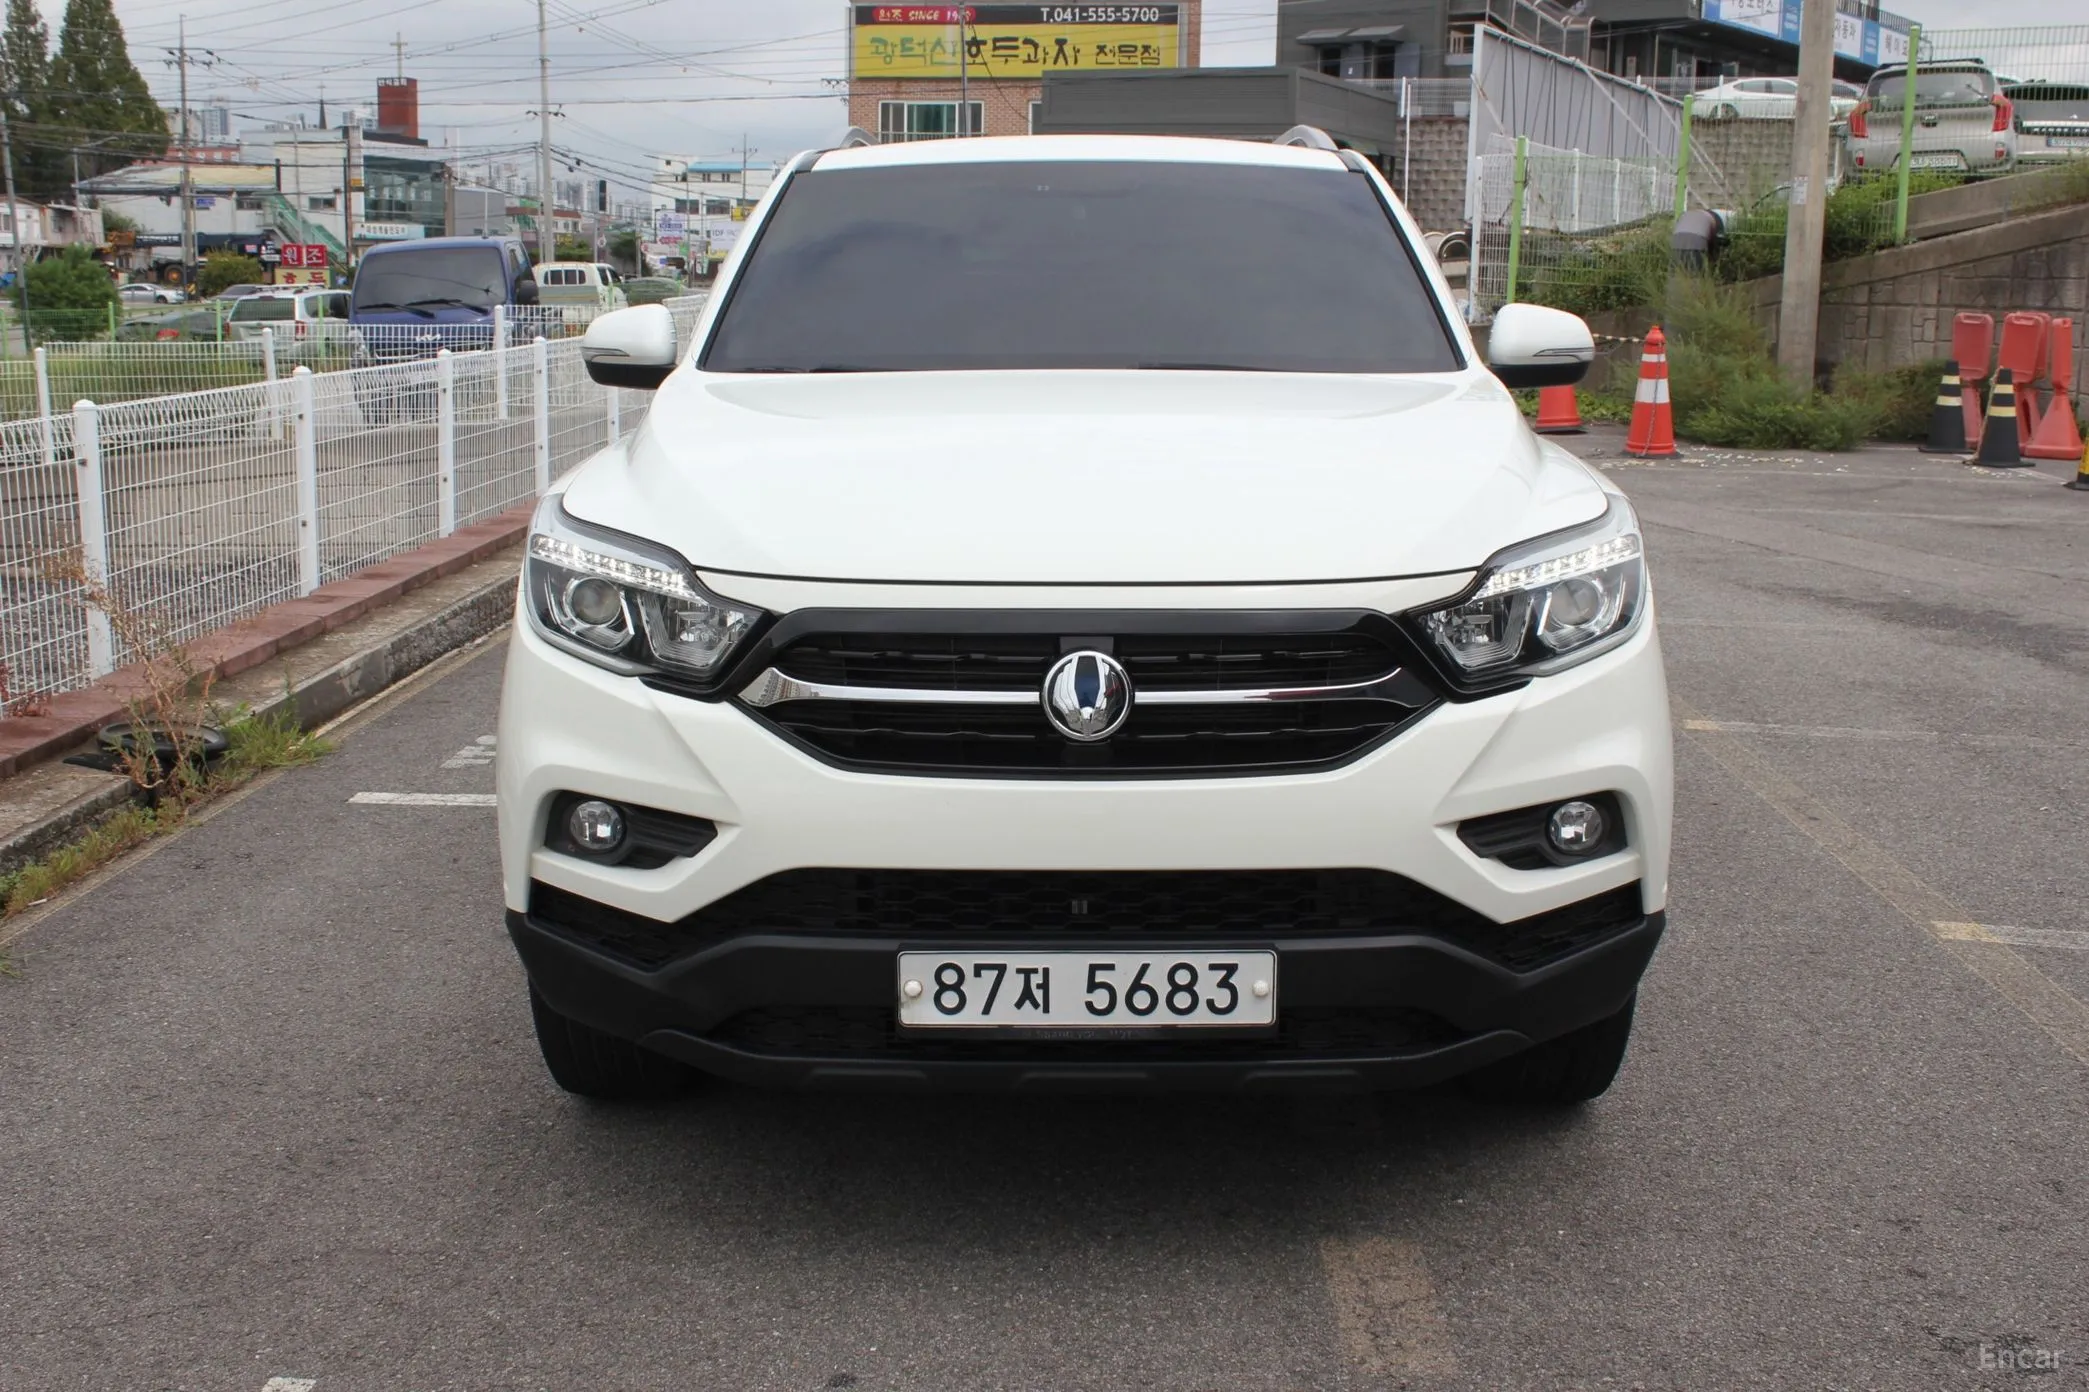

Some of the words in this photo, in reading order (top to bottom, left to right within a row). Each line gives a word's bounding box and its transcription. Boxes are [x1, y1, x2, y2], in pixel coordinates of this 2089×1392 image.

[908, 10, 940, 21] SINCE
[1040, 7, 1160, 23] T.041-555-5700
[1095, 44, 1161, 66] 전문점
[932, 961, 1051, 1017] 87저
[1083, 961, 1241, 1017] 5683
